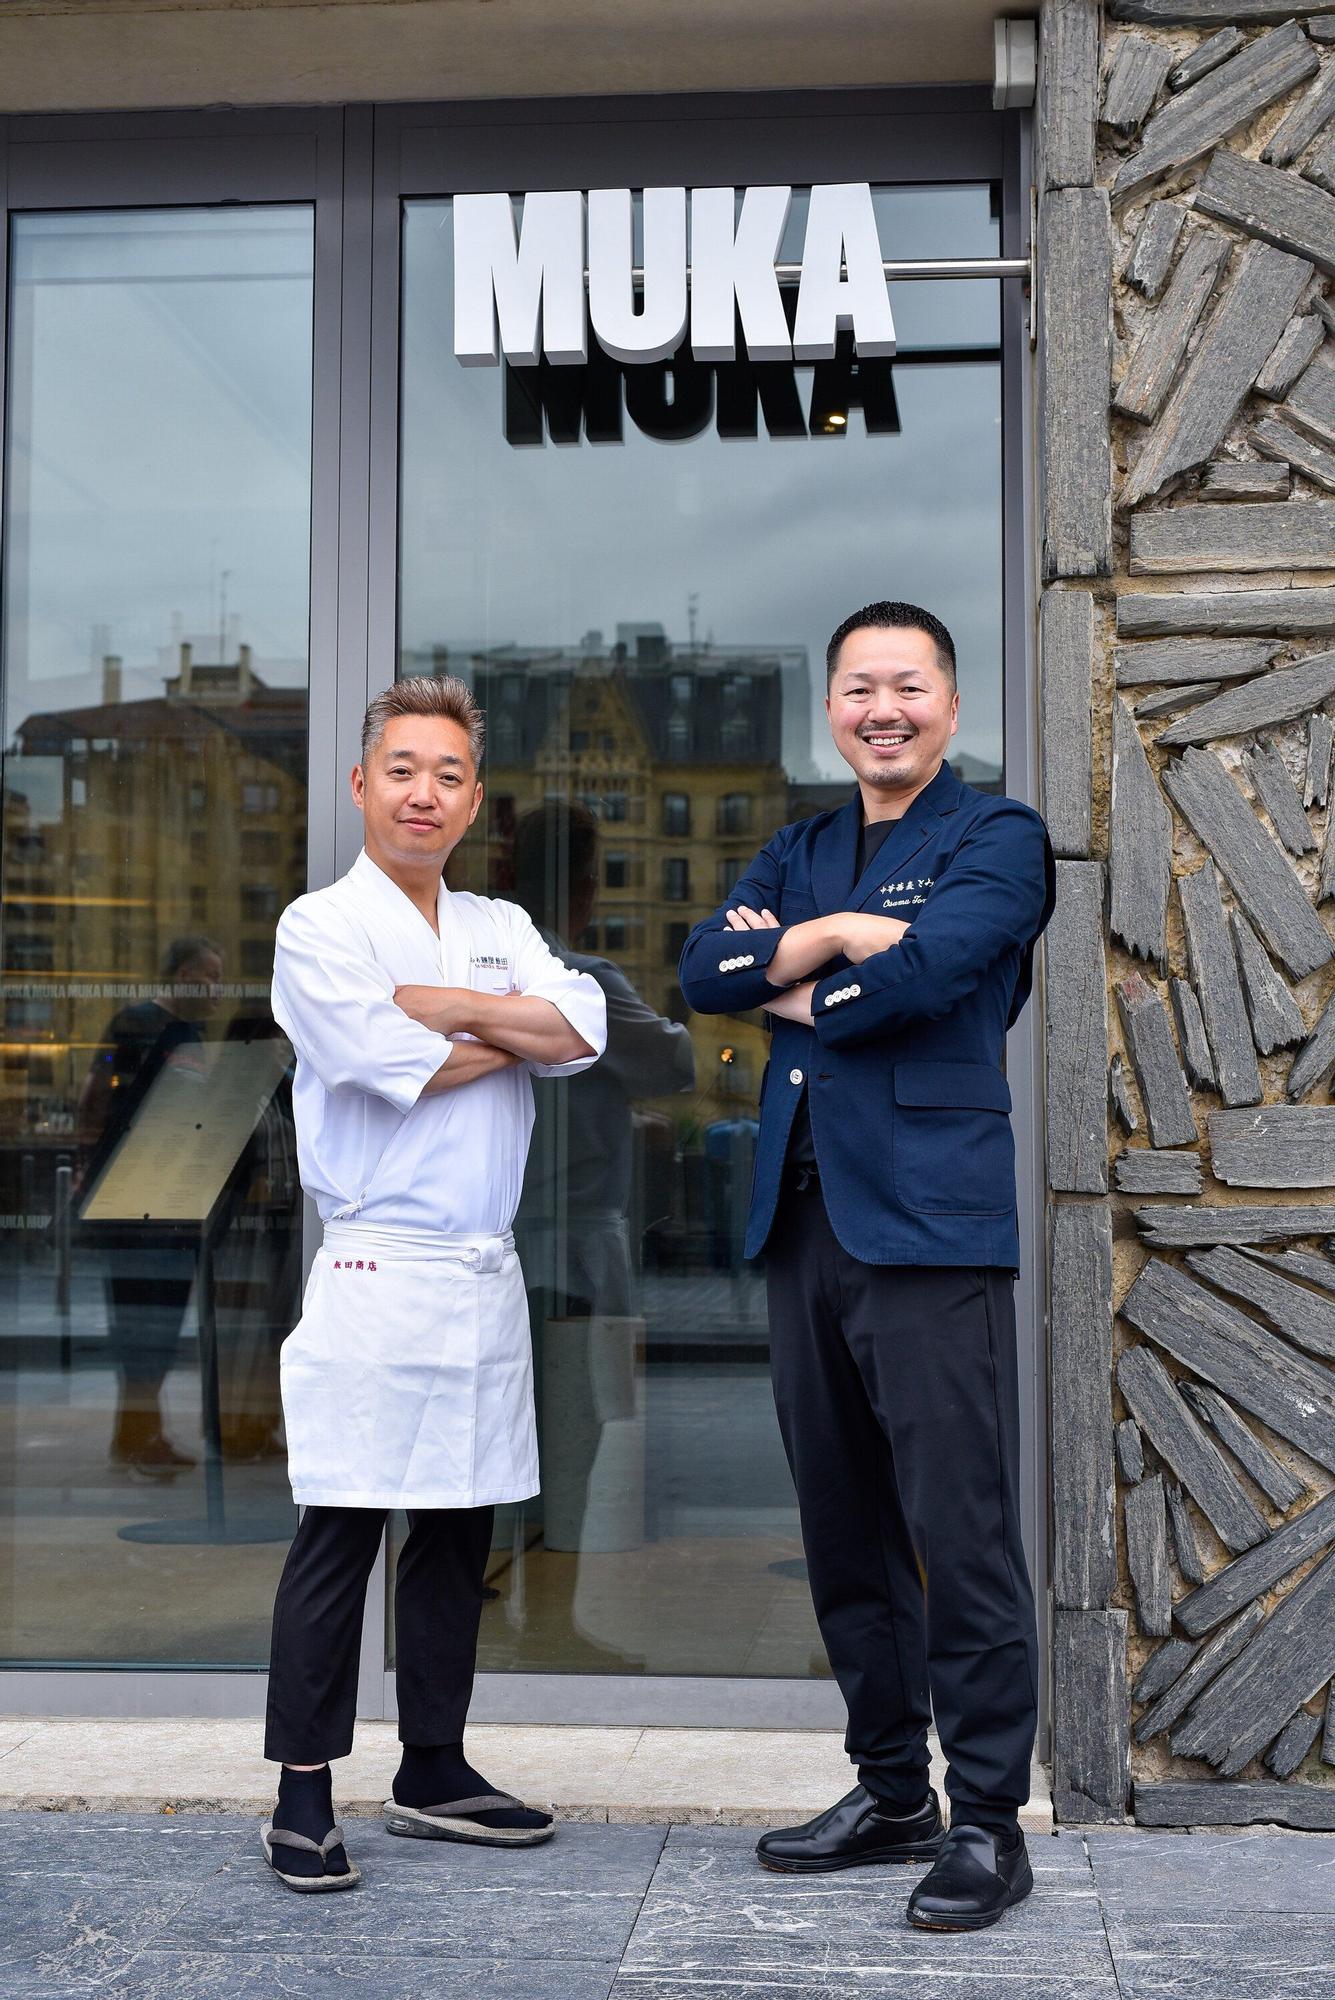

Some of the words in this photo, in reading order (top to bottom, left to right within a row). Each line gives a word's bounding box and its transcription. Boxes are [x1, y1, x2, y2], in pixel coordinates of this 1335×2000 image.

[453, 183, 896, 367] MUKA
[32, 984, 66, 998] MUKA
[67, 984, 101, 998] MUKA
[103, 984, 137, 998] MUKA
[138, 984, 172, 998] MUKA
[174, 984, 208, 998] MUKA
[0, 1215, 25, 1229] UKA
